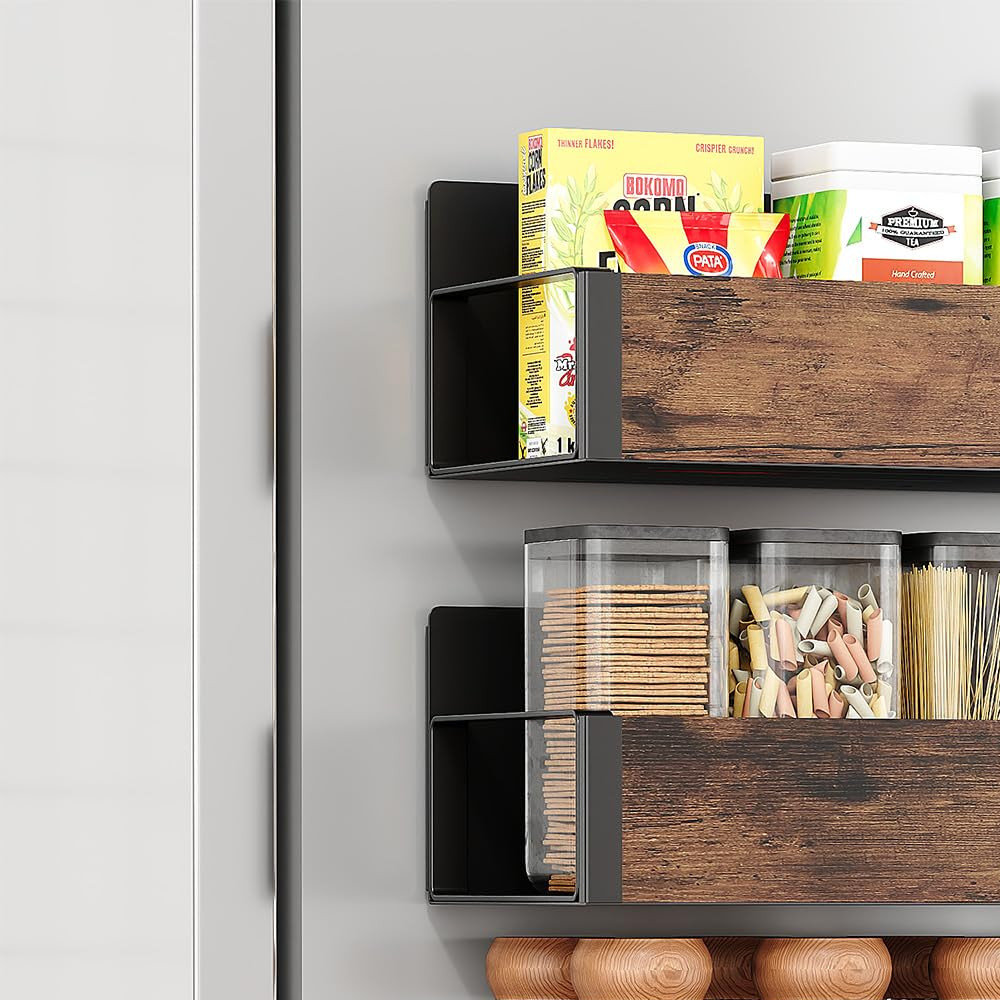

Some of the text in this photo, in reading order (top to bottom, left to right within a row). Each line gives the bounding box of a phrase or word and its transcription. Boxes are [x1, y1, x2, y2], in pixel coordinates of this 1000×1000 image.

[558, 138, 614, 149] THINNER FLAKES!
[696, 143, 726, 154] CRISPIER
[626, 176, 684, 196] BOKOMO
[888, 216, 940, 228] PREMIUM
[906, 238, 919, 247] TEA
[892, 270, 936, 279] Hand Crafted
